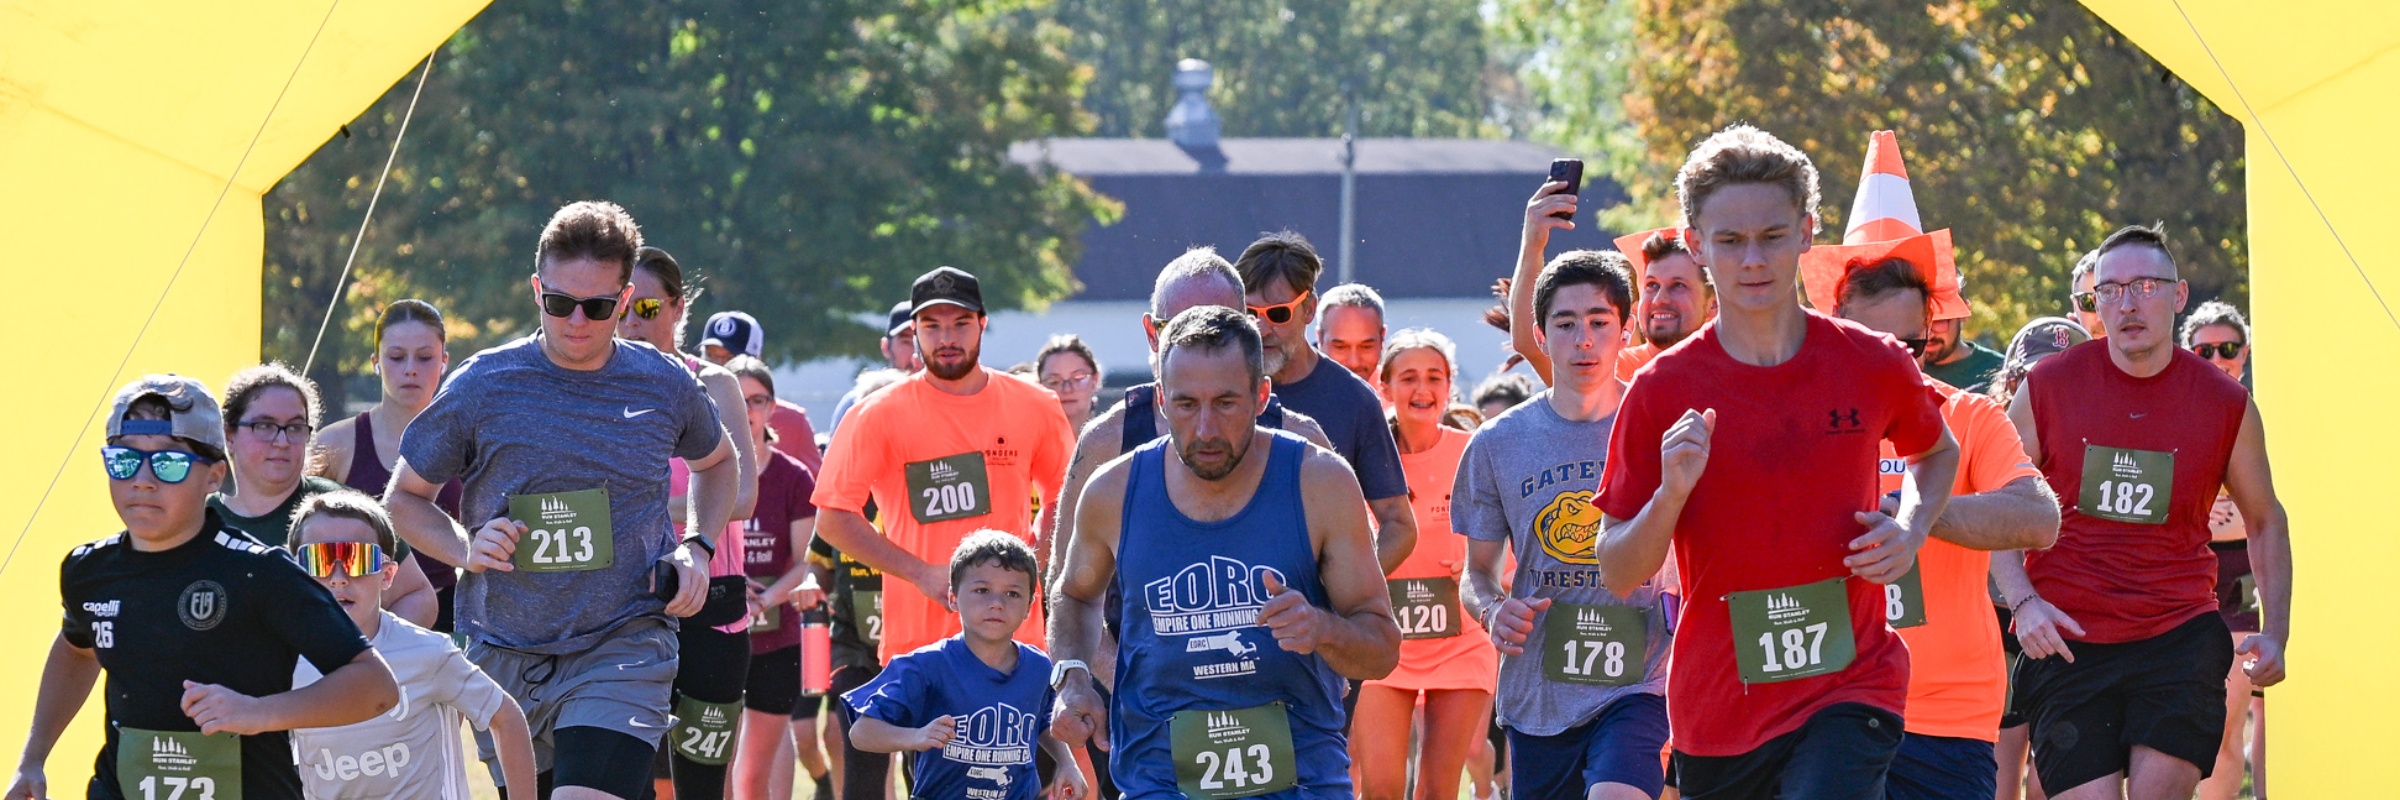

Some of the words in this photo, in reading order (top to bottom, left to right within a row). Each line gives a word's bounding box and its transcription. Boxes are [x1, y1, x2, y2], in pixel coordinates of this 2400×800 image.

[2053, 328, 2070, 348] B
[923, 481, 976, 517] 200
[2097, 480, 2154, 516] 182
[531, 526, 594, 564] 213
[747, 550, 755, 563] &
[756, 550, 773, 563] Roll
[83, 600, 121, 617] capelli
[1154, 616, 1189, 633] EMPIRE
[1190, 613, 1212, 630] ONE
[1213, 609, 1259, 628] RUNNING
[1399, 604, 1447, 633] 120
[1783, 609, 1810, 618] STANLEY
[91, 621, 114, 648] 26
[1190, 638, 1207, 649] EORC
[1758, 621, 1828, 672] 187
[1193, 663, 1239, 676] WESTERN
[1240, 660, 1256, 672] MA
[1563, 639, 1625, 677] 178
[681, 726, 732, 758] 247
[1223, 728, 1250, 737] STANLEY
[315, 742, 410, 781] Jeep
[945, 744, 974, 761] EMPIRE
[975, 748, 991, 762] ONE
[1195, 743, 1273, 790] 243
[139, 775, 216, 800] 173
